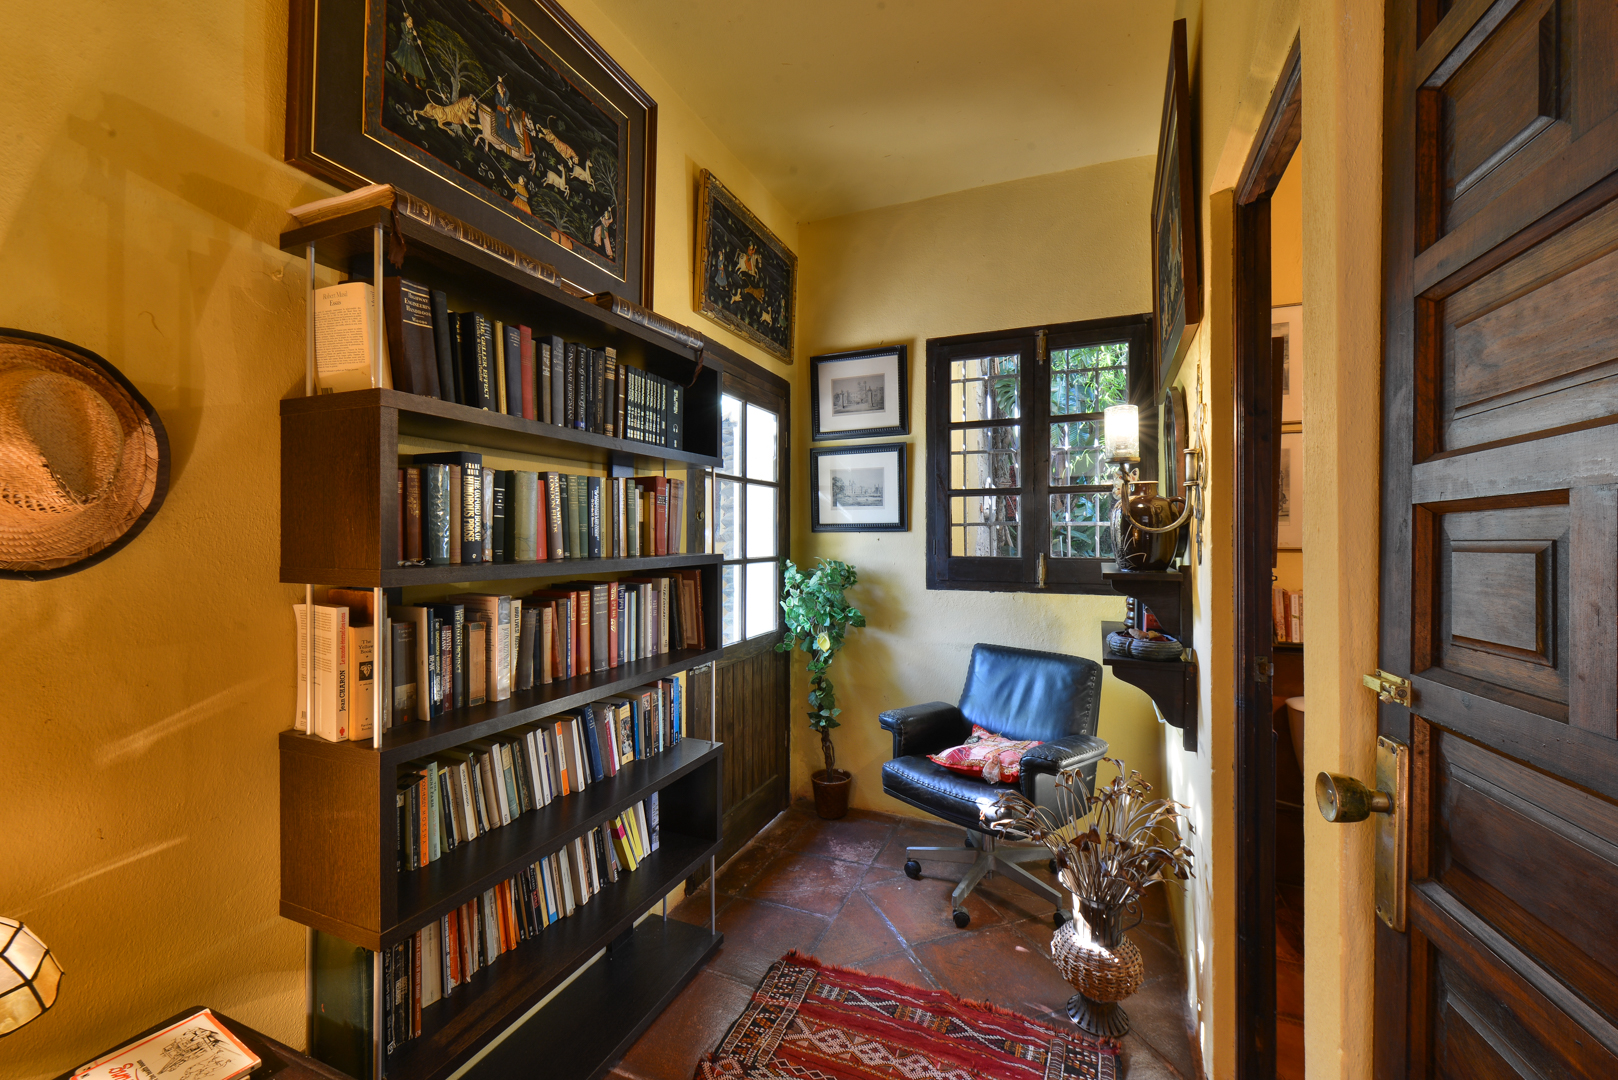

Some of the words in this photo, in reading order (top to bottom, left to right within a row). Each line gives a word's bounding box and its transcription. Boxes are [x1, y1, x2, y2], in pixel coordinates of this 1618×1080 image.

[480, 337, 488, 367] GELLER
[463, 475, 475, 517] HUMOROUS
[464, 518, 475, 542] PROSE
[475, 533, 481, 542] OF
